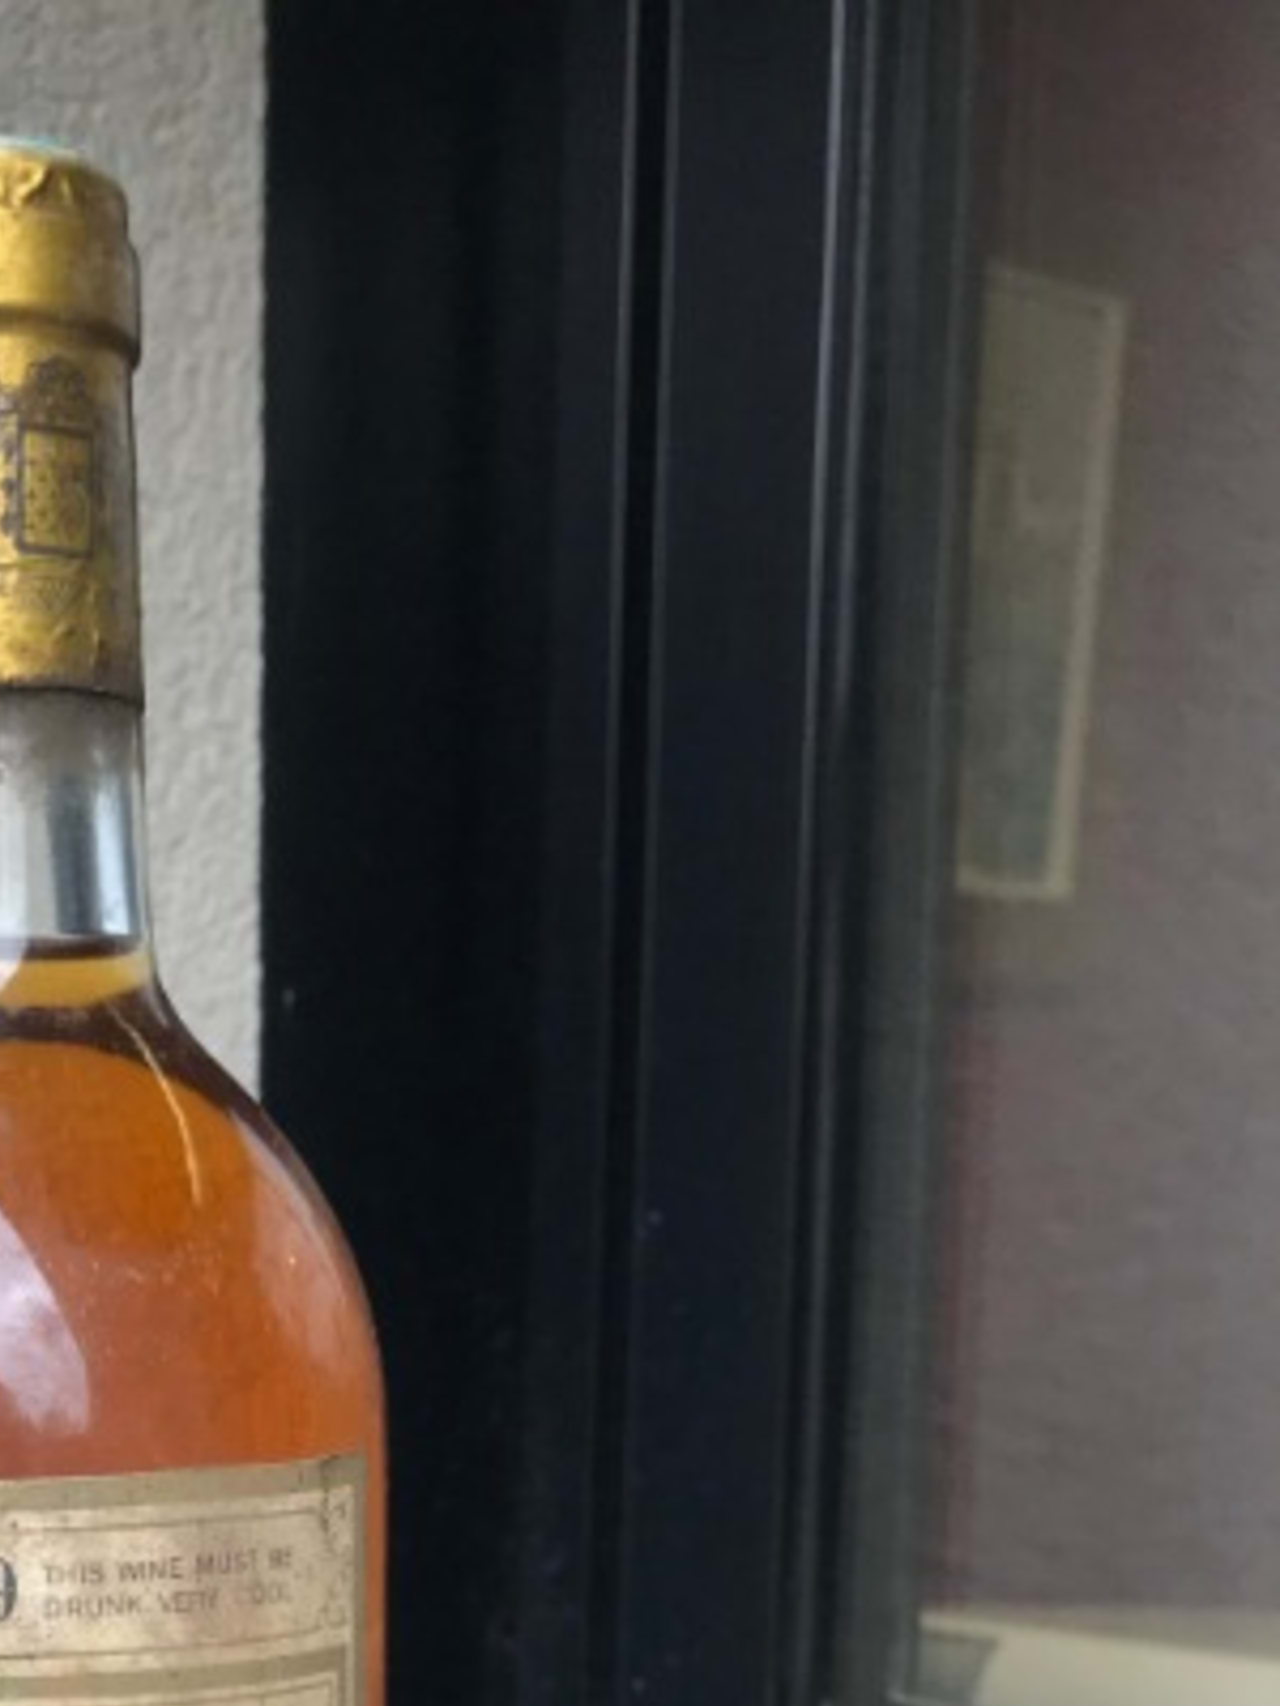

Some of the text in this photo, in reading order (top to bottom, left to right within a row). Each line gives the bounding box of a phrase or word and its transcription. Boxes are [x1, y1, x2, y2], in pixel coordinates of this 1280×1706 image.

[43, 1561, 105, 1585] THIS
[117, 1555, 184, 1583] WINE
[195, 1547, 258, 1576] MUST
[43, 1592, 142, 1622] DRUNK
